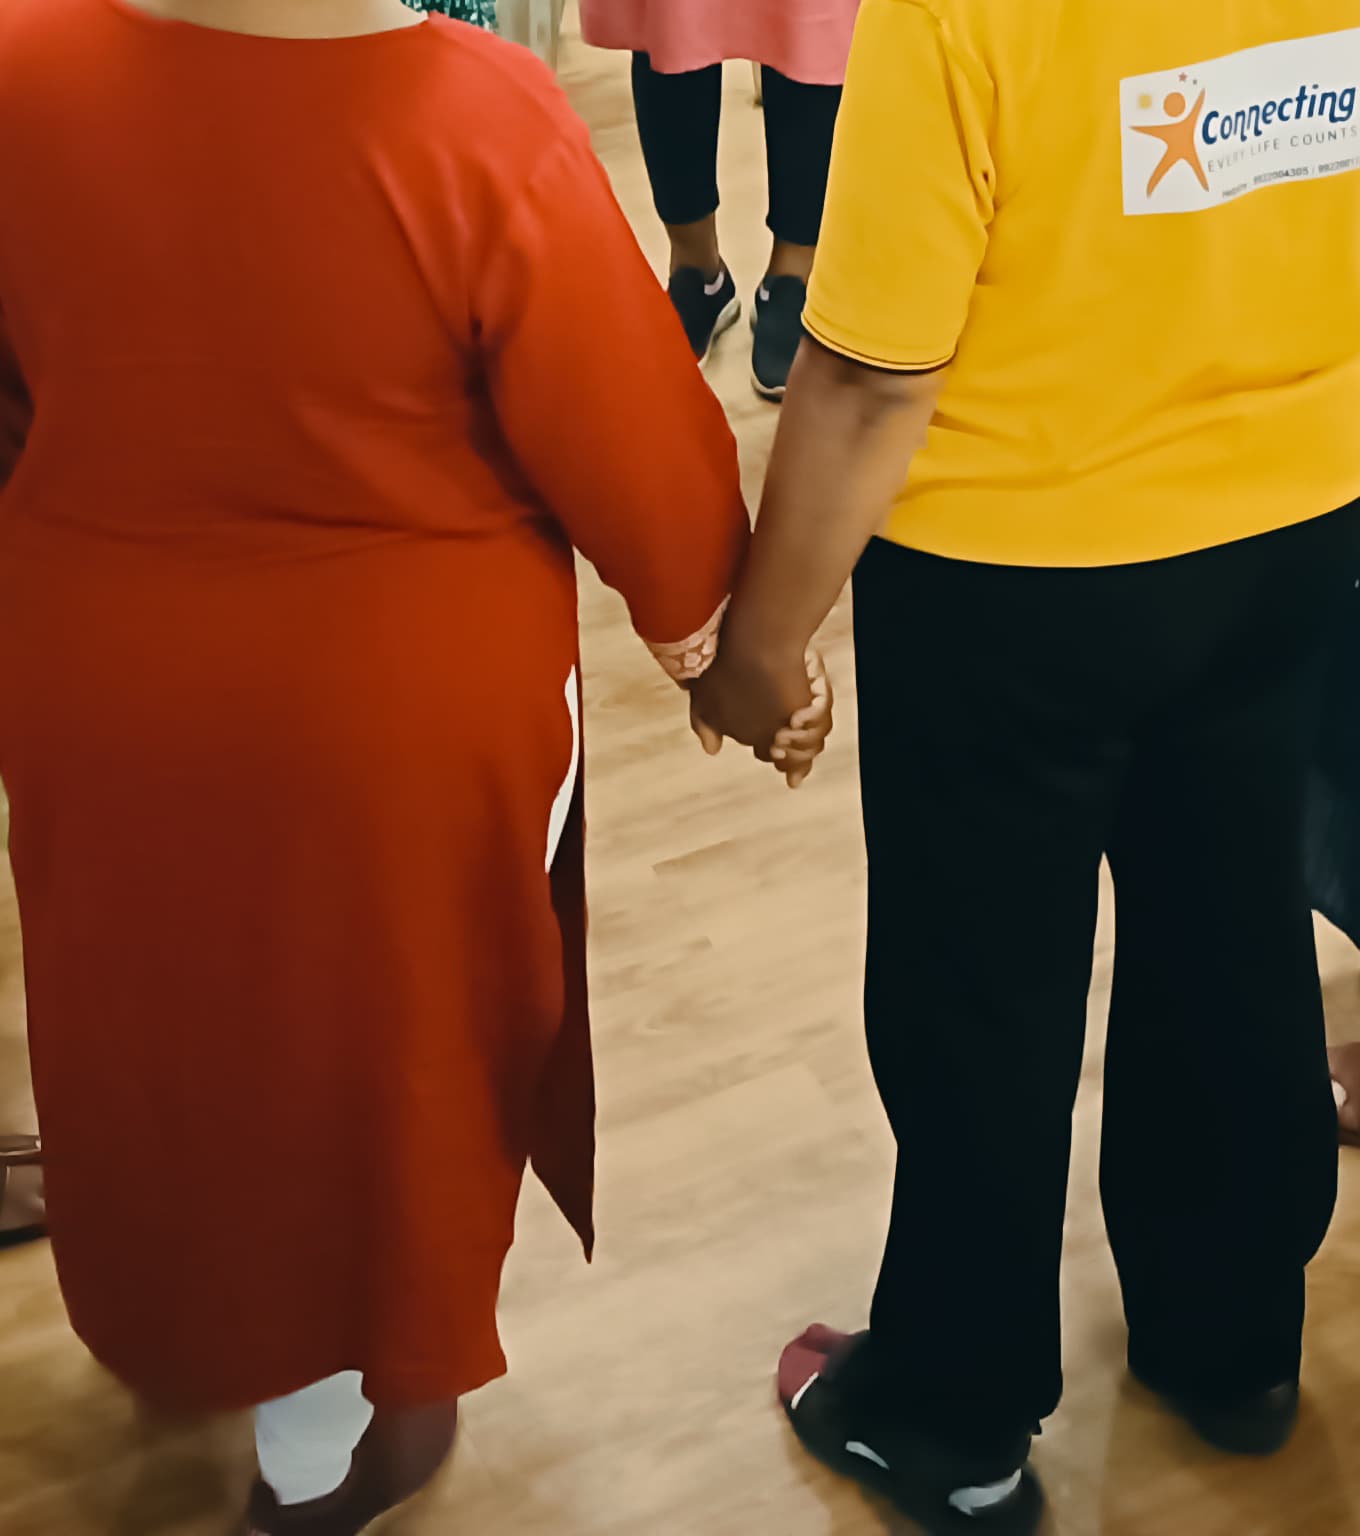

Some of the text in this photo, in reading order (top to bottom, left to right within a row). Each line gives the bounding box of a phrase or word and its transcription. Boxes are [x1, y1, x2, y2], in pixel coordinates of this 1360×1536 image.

[1202, 83, 1357, 145] Connecting
[1250, 137, 1280, 157] LIFE
[1290, 125, 1359, 148] COUNTS
